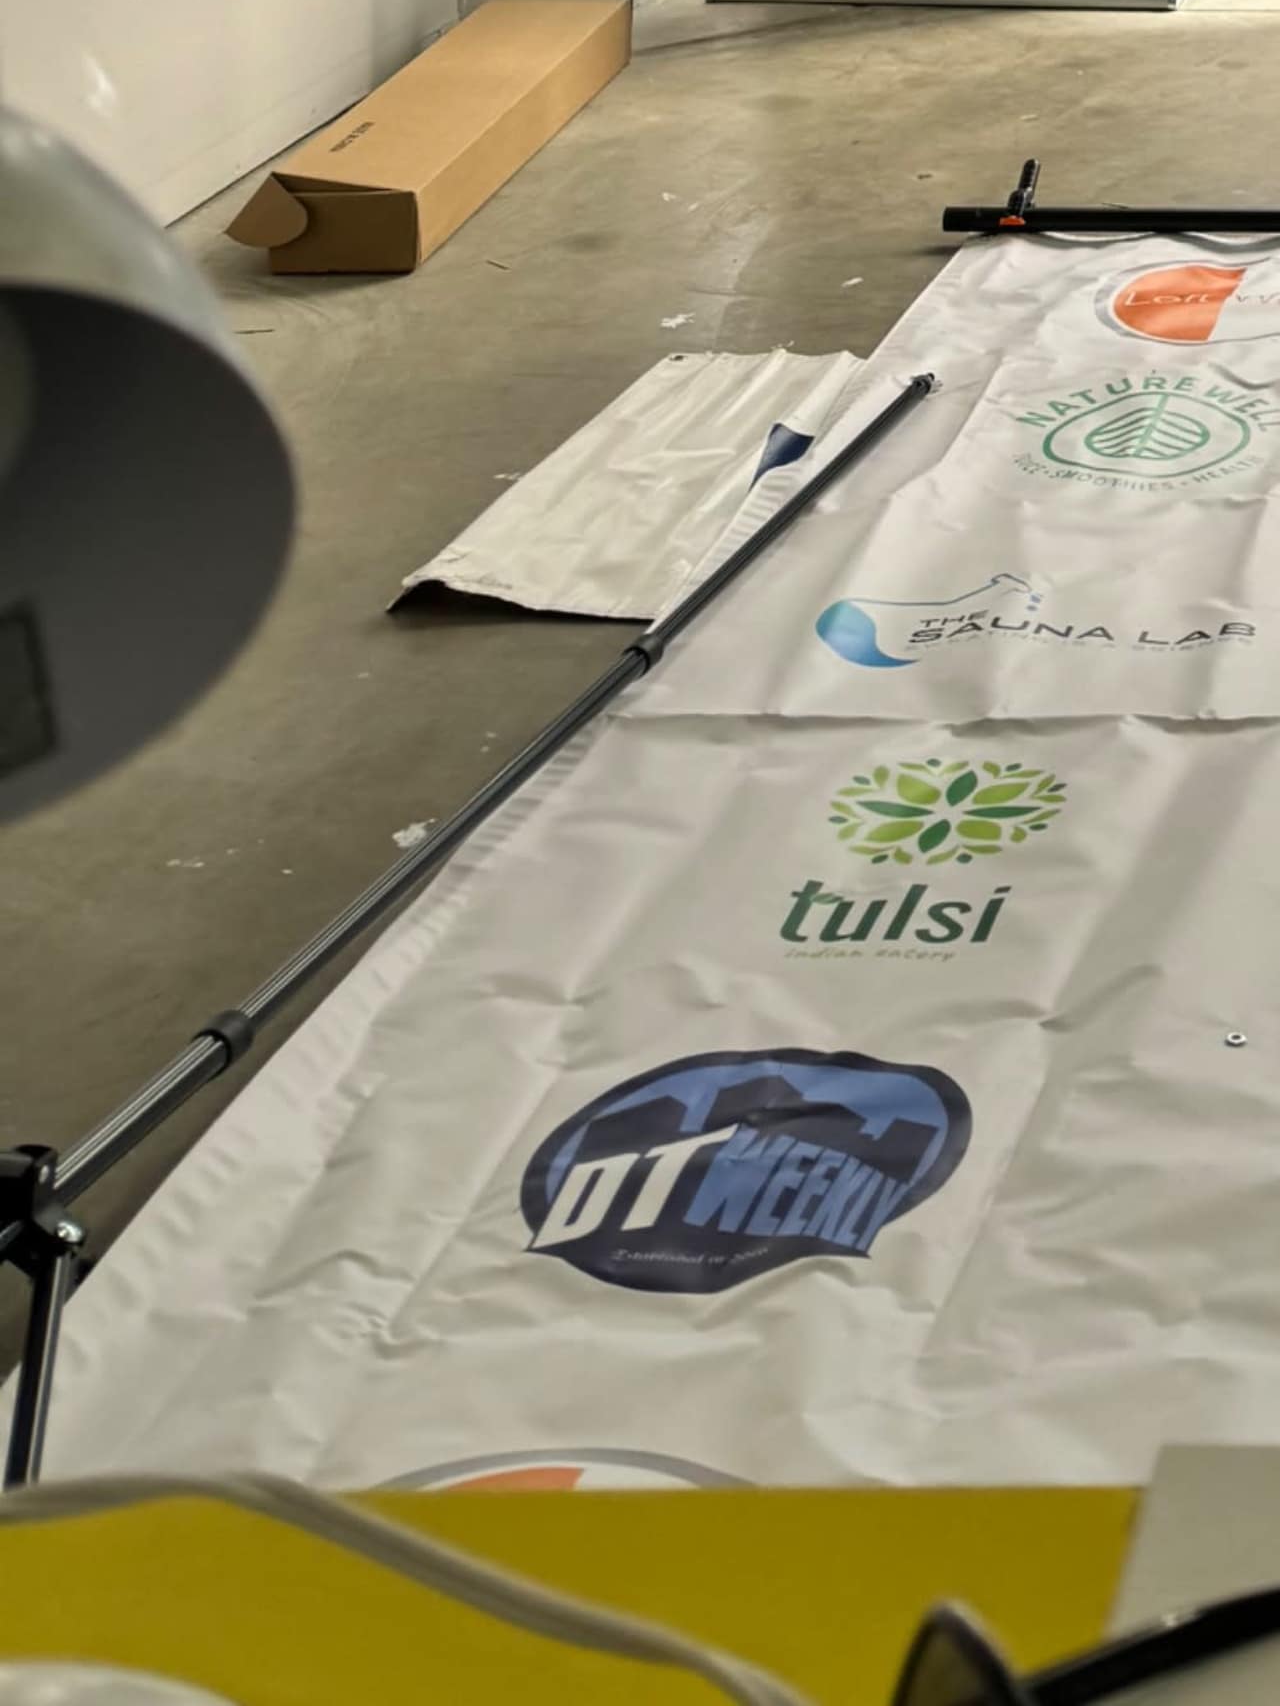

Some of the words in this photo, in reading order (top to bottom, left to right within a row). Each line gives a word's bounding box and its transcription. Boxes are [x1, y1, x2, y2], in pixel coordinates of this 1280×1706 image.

[909, 616, 1115, 644] SAUNA
[1137, 622, 1257, 646] LAB
[779, 879, 1013, 944] tulsi
